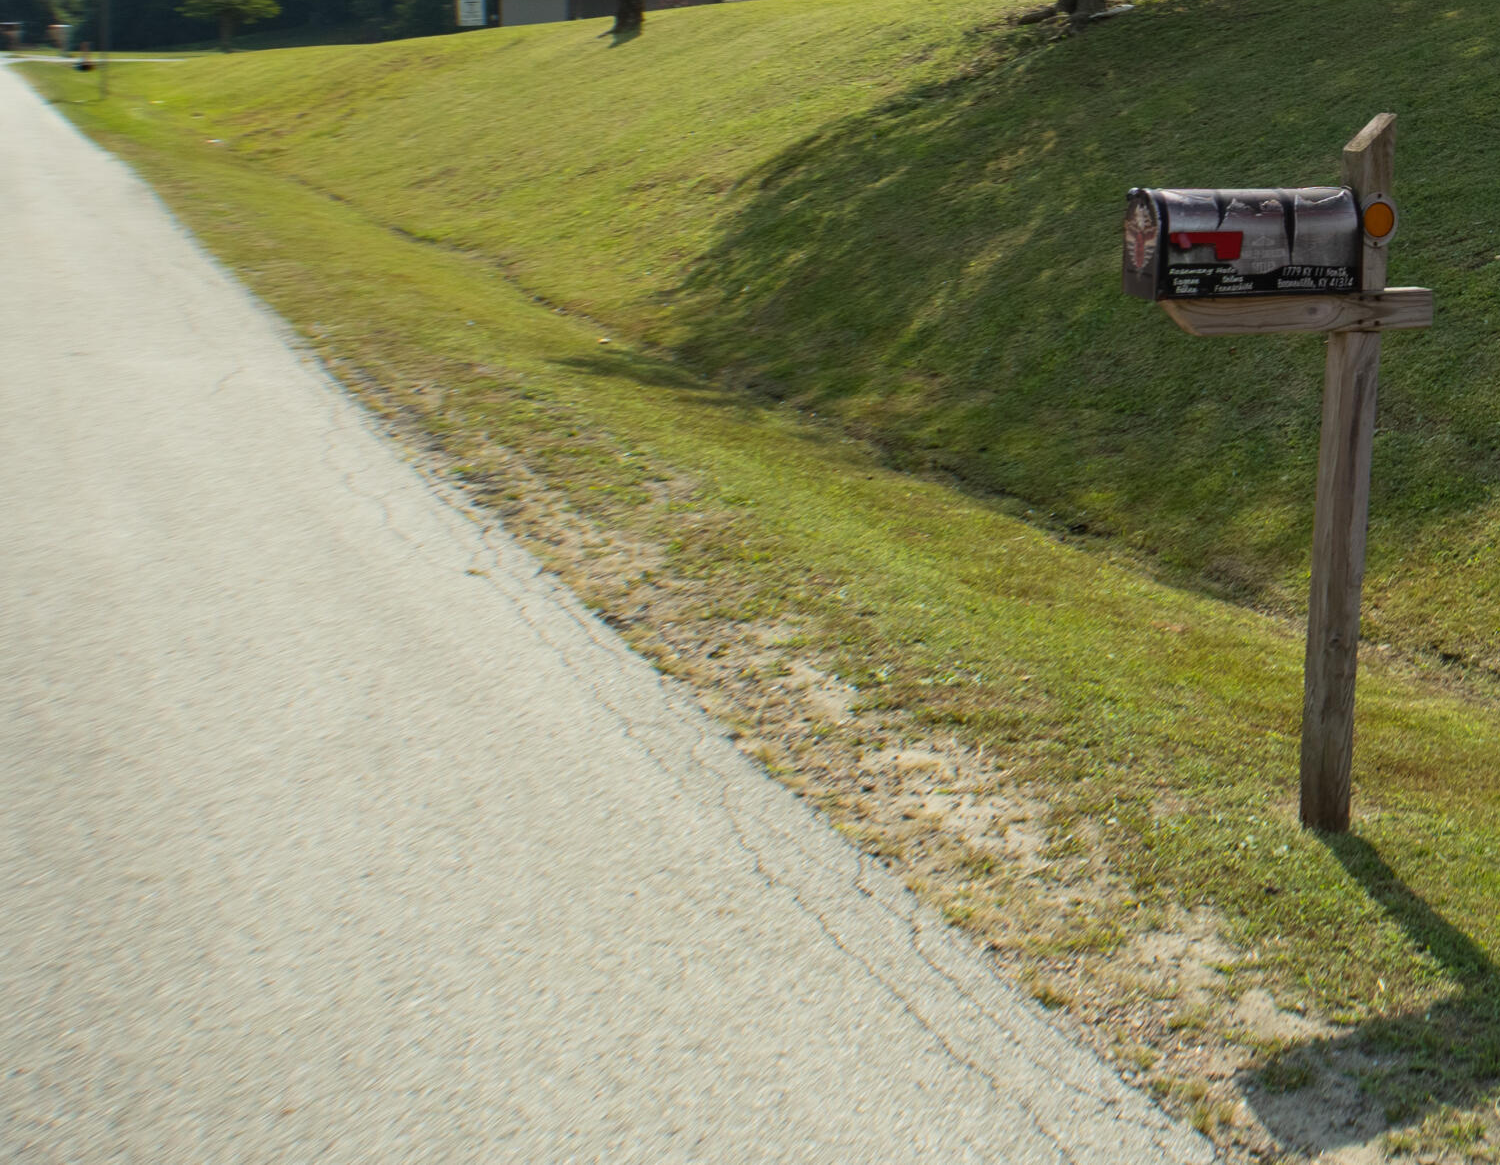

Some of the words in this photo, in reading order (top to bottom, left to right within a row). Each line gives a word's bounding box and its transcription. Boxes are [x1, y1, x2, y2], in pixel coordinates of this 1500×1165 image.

[1282, 266, 1302, 276] 1779
[1303, 266, 1313, 276] KY
[1315, 266, 1324, 276] 11
[1318, 277, 1328, 287] KY
